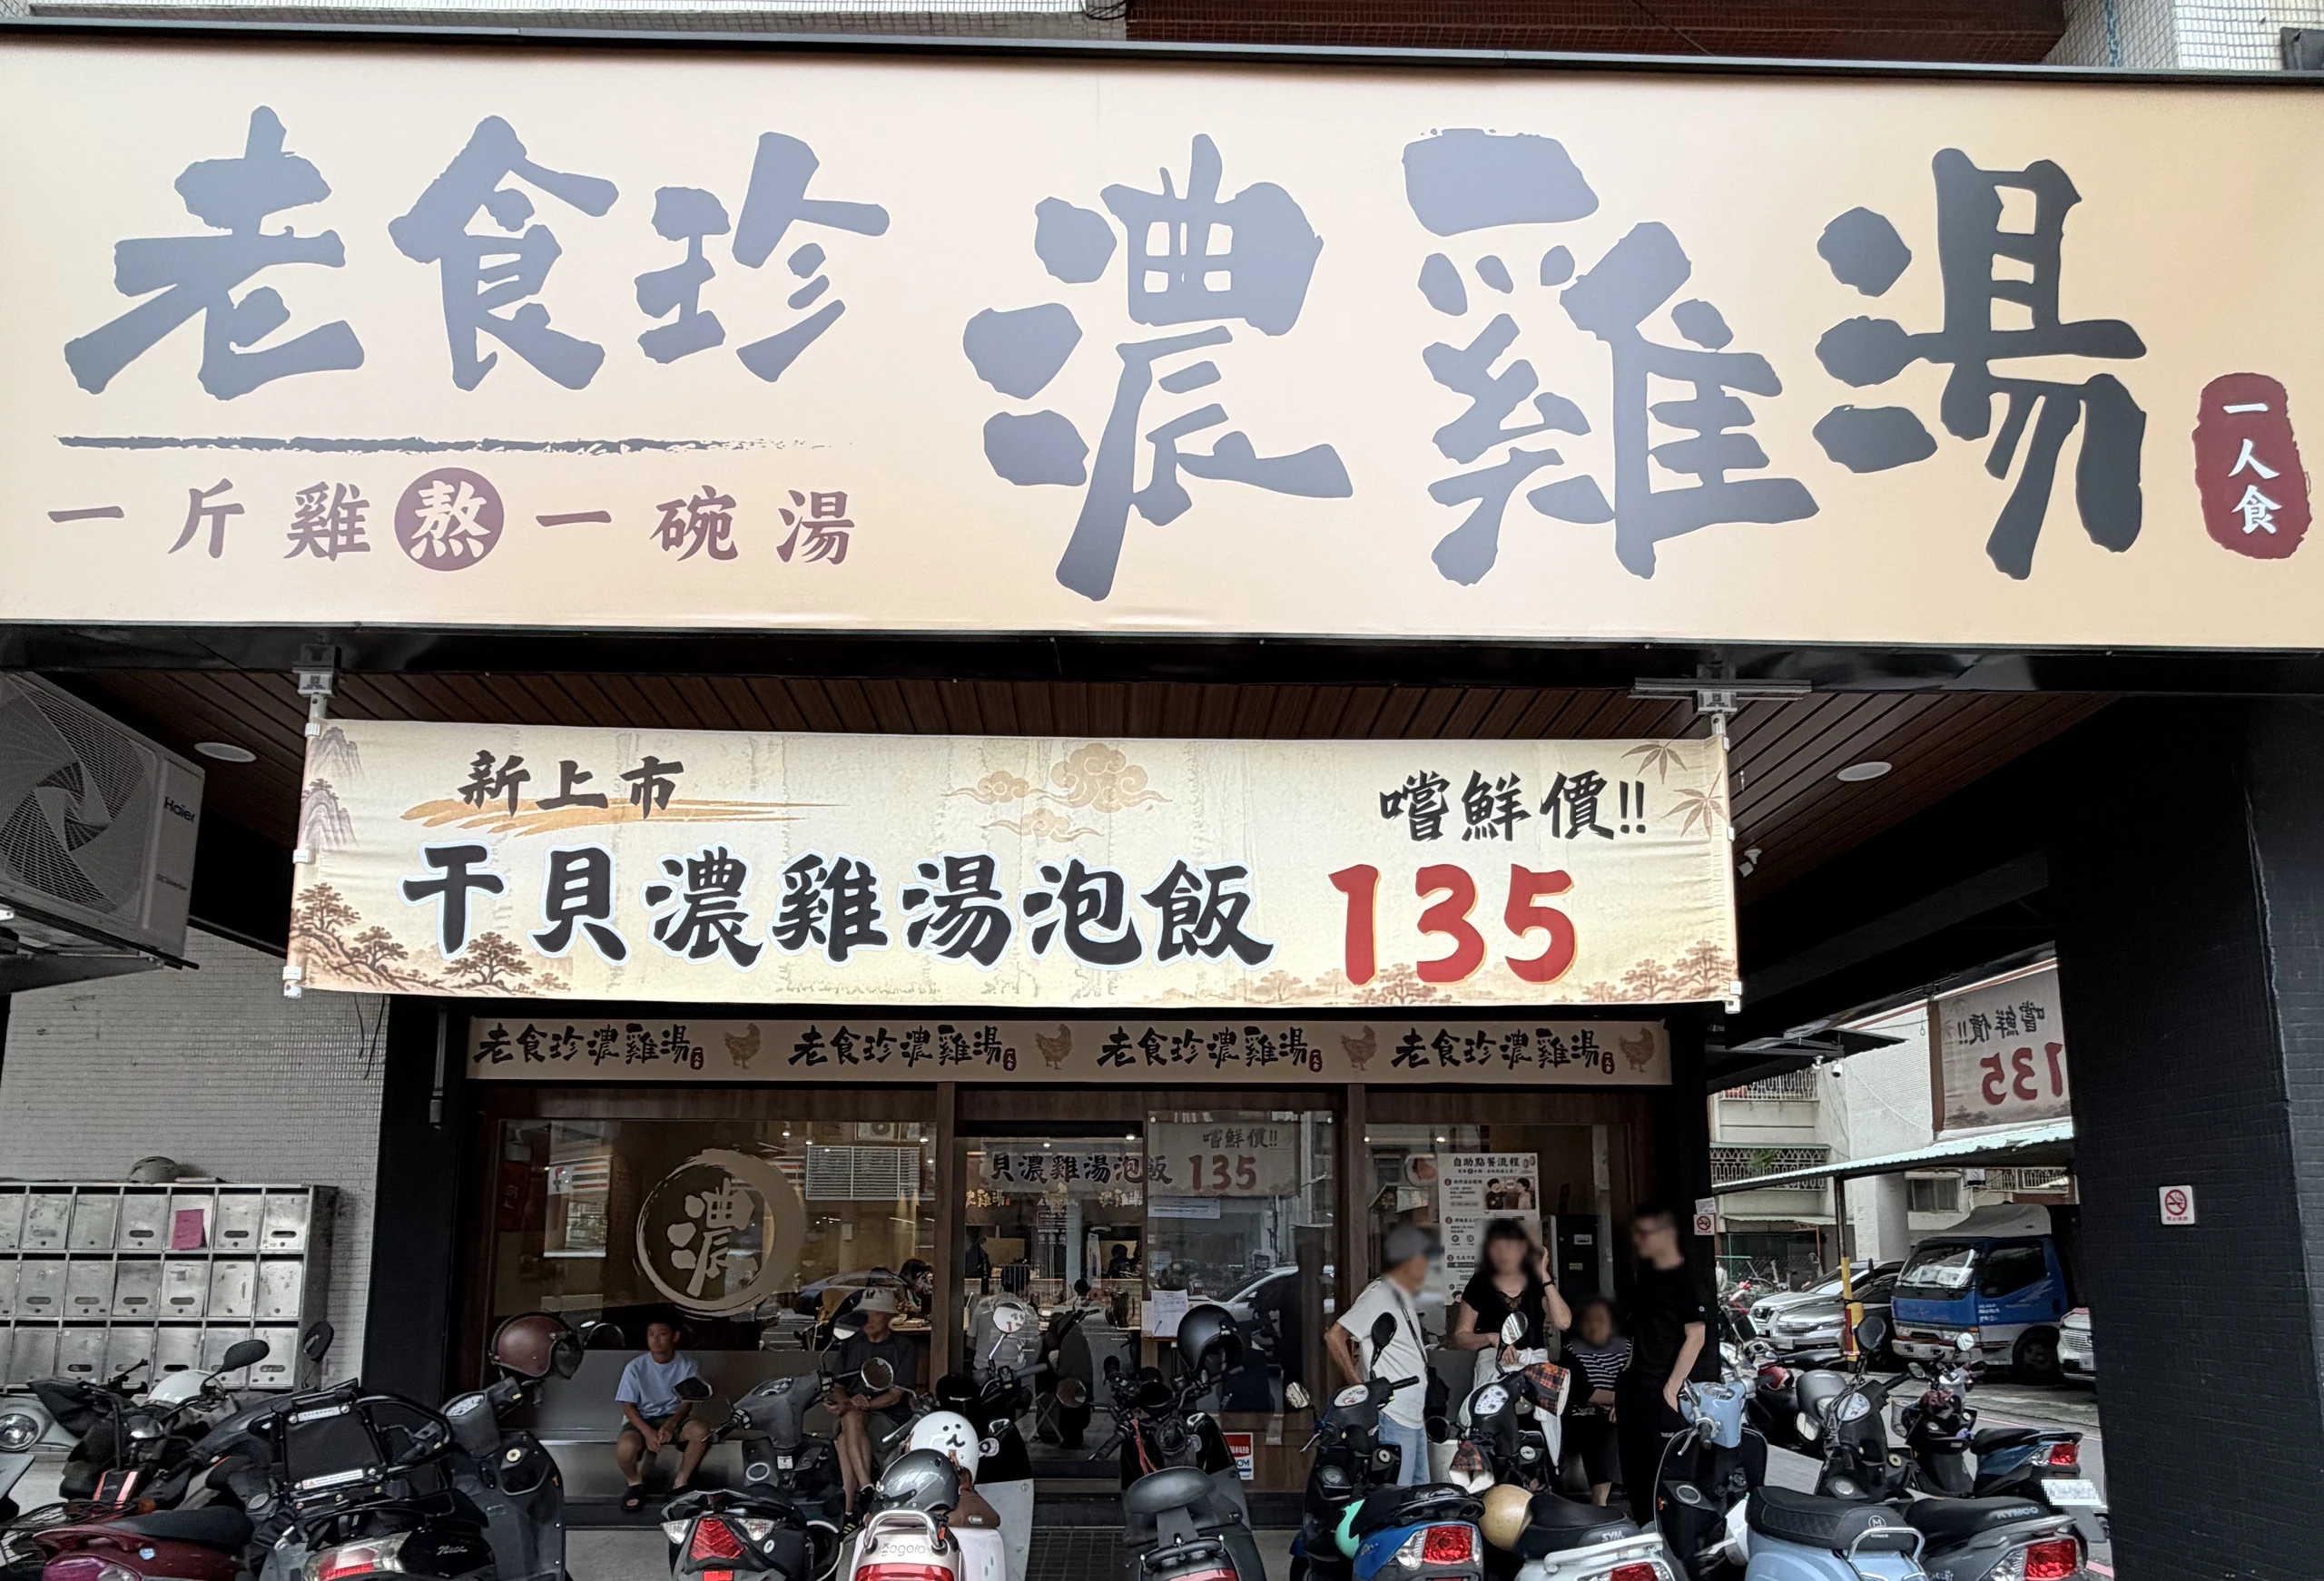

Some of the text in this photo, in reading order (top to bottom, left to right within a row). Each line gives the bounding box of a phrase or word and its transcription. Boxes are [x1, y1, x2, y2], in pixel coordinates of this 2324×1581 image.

[64, 105, 2147, 601] 老食珍 濃雞湯
[2222, 402, 2281, 535] 一人食
[47, 479, 855, 561] 一斤雞熬一碗湯
[457, 750, 684, 820] 新上市
[164, 797, 196, 822] Haier
[402, 845, 1273, 968] 干貝濃雞湯泡飯
[1327, 863, 1579, 986] 135
[473, 1022, 691, 1065] 老食珍濃雞湯
[788, 1024, 1002, 1067] 老食珍濃雞湯
[1097, 1026, 1308, 1069] 老食珍濃雞湯
[1391, 1027, 1600, 1070] 老食珍濃雞湯
[1188, 1154, 1257, 1192] 135
[1453, 1156, 1520, 1167] 自助點餐流程
[667, 1177, 760, 1298] 濃
[1996, 1507, 2039, 1519] KYMCO
[1601, 1529, 1624, 1542] SYM
